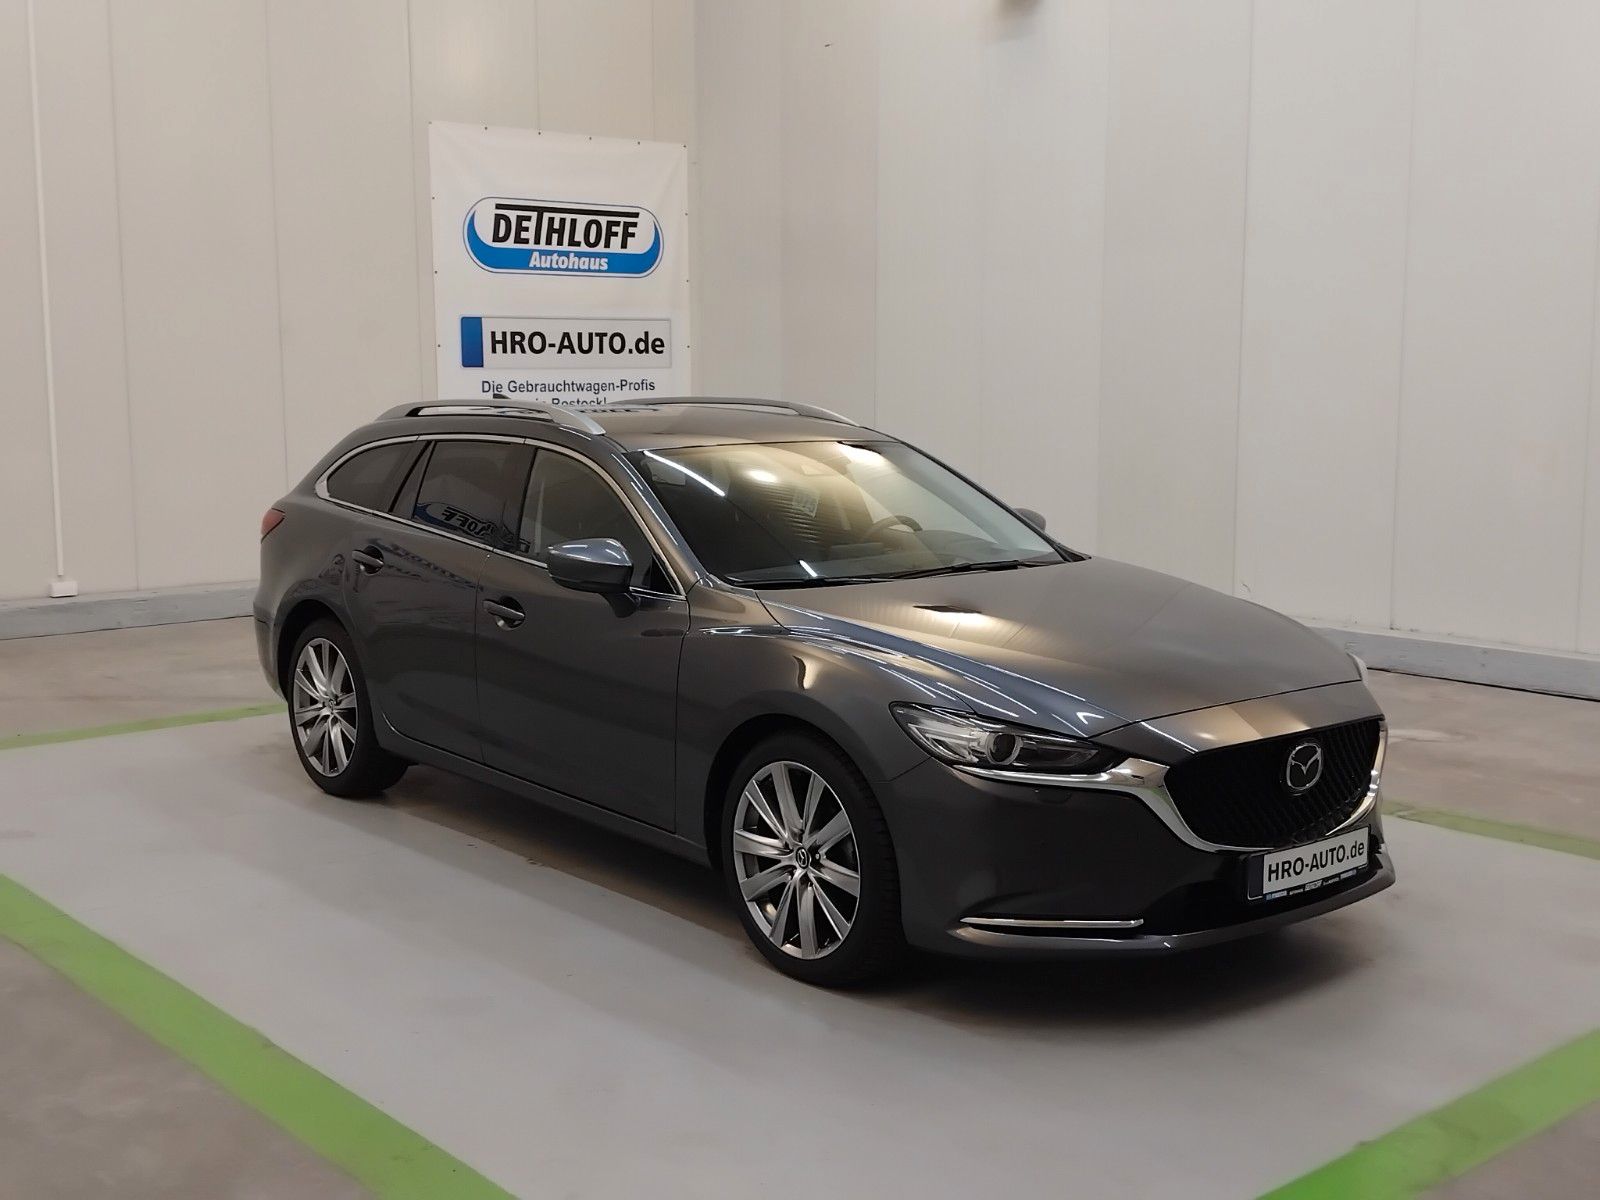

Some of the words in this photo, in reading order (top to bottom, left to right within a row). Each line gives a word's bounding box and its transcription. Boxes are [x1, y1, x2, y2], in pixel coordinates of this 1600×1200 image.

[492, 203, 640, 250] DETHLOFF
[529, 252, 609, 270] Autohaus
[490, 331, 665, 354] HRO-AUTO.de
[482, 381, 503, 393] Die
[507, 379, 656, 395] Gebrauchtwagen-Profis
[1268, 841, 1365, 882] HRO-AUTO.de
